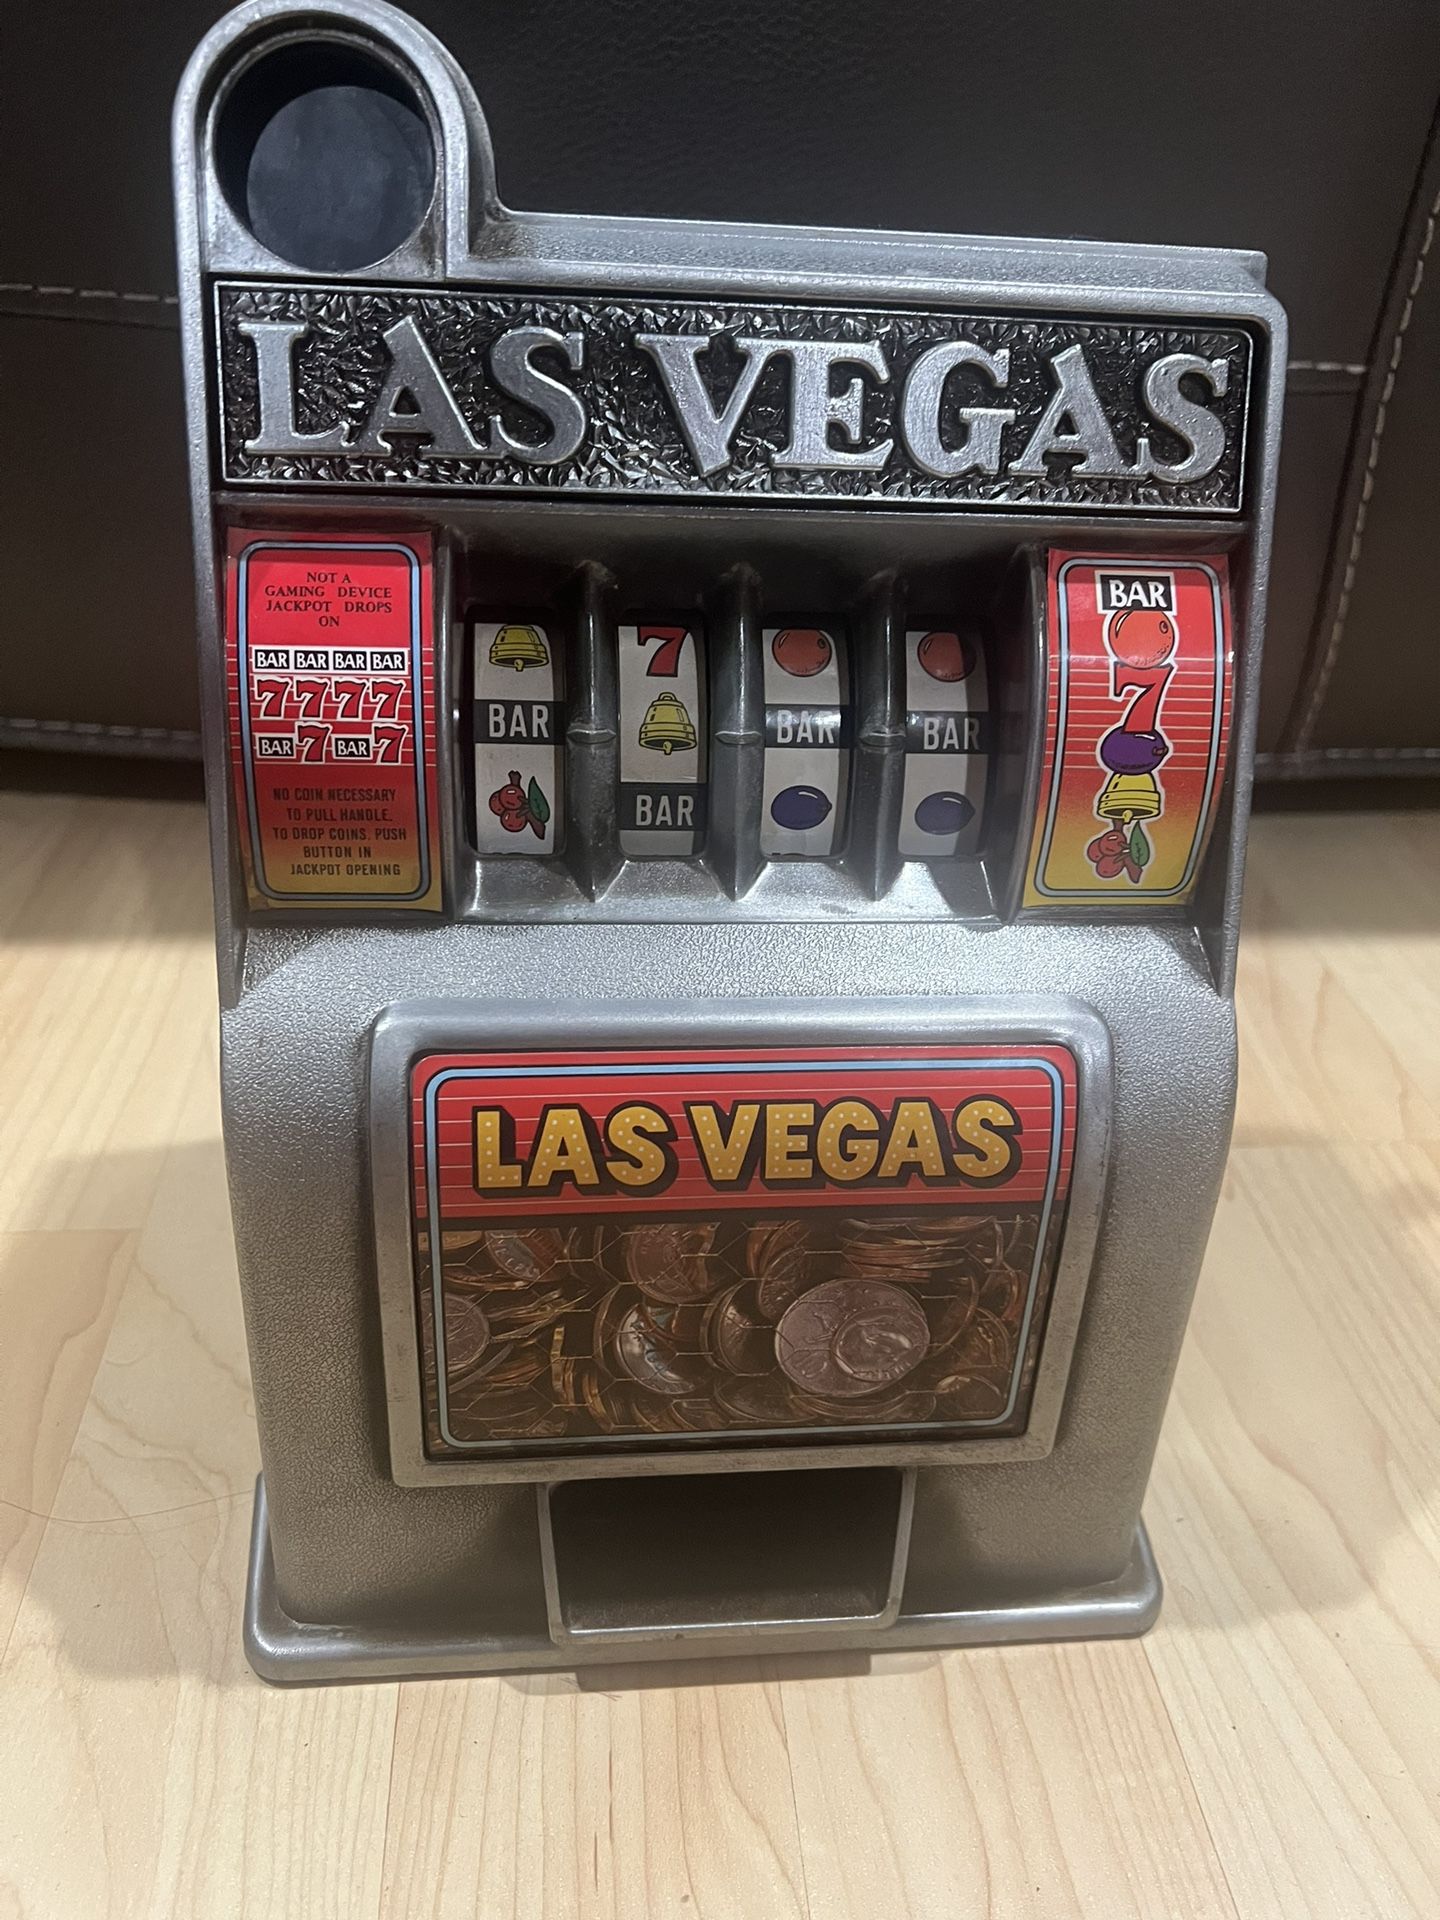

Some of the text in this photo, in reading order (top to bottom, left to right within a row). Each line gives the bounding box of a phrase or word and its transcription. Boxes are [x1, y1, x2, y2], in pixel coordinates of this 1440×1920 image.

[238, 315, 1229, 484] LAS VEGAS
[265, 586, 392, 598] GAMING DEVICE
[307, 572, 351, 583] NOT A
[266, 601, 392, 613] JACKPOT DROPS
[1109, 579, 1168, 608] BAR
[319, 616, 340, 627] ON
[256, 651, 404, 670] BAR BAR BAR BAR
[637, 626, 689, 677] 7
[256, 679, 405, 719] 7 7 7 7
[1113, 661, 1177, 733] 7
[489, 703, 549, 739] BAR
[776, 709, 835, 744] BAR
[923, 716, 980, 750] BAR
[261, 724, 408, 764] BAR 7 BAR 7
[272, 788, 396, 801] NO COIN NECESSARY
[287, 808, 300, 821] TO
[306, 808, 337, 822] PULL
[635, 794, 694, 827] BAR
[272, 827, 288, 840] TO
[292, 828, 325, 840] DROP
[375, 828, 407, 841] PUSH
[303, 846, 372, 858] BUTTON IN
[290, 864, 401, 876] JACKPOT OPENING
[474, 1099, 1018, 1193] LAS VEGAS
